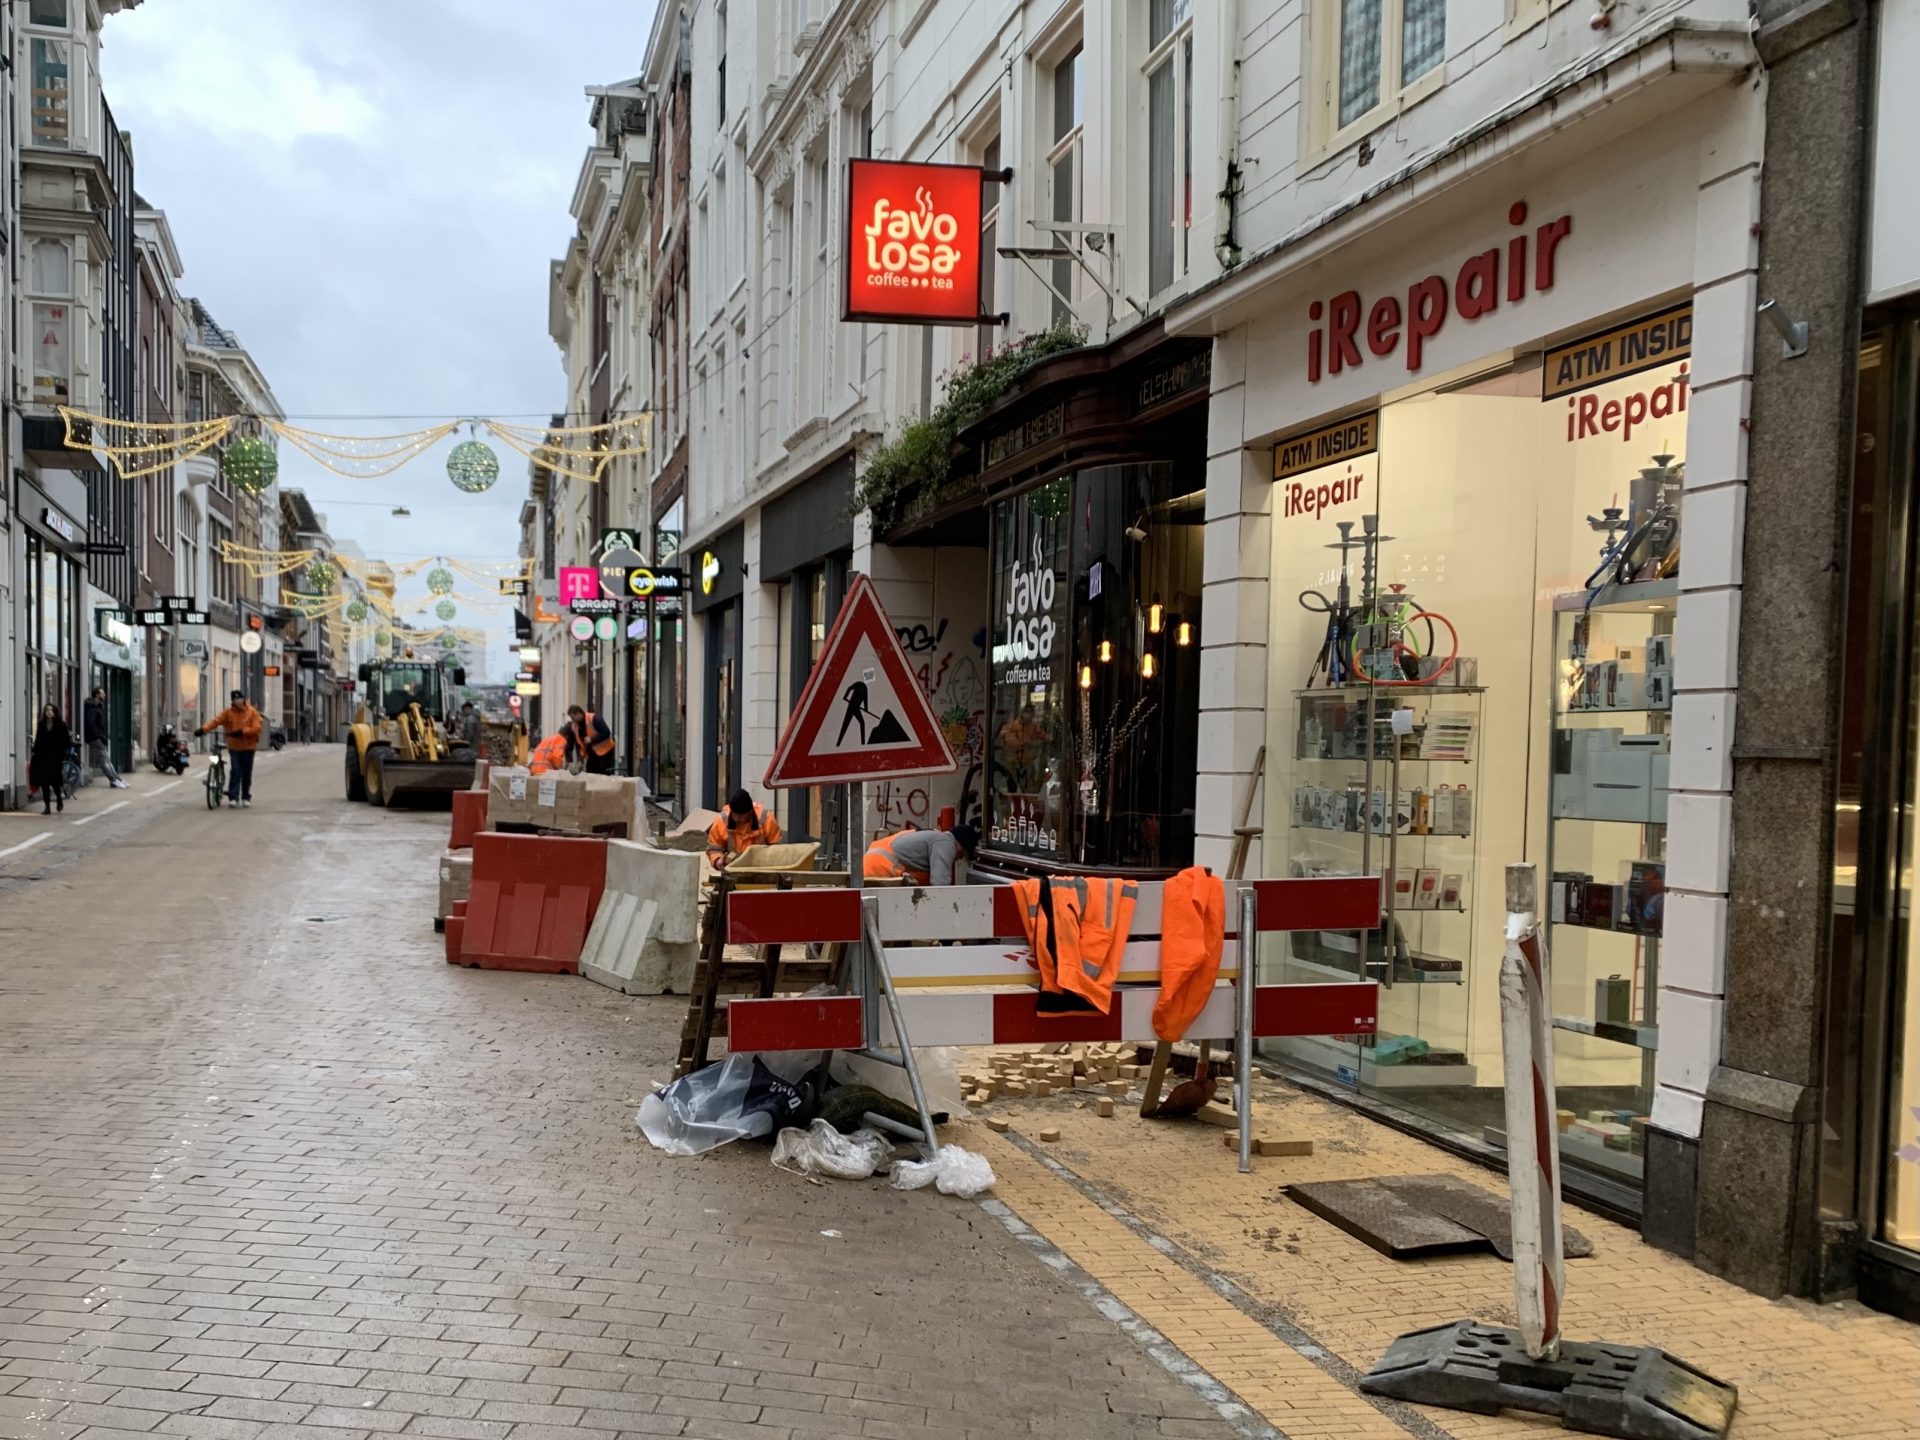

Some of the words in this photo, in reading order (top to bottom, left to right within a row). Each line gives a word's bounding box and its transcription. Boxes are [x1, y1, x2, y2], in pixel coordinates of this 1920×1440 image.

[864, 198, 958, 242] favo
[866, 234, 961, 274] losa
[867, 272, 909, 287] coffee
[931, 275, 954, 289] tea
[1308, 200, 1572, 383] iRepair
[1556, 342, 1612, 386] ATM
[1619, 315, 1693, 366] INSID
[1567, 361, 1689, 443] iRepai
[1281, 440, 1313, 471] ATM
[1316, 422, 1370, 460] INSIDE
[1284, 464, 1364, 521] iRepair
[168, 599, 189, 609] WE
[568, 573, 590, 598] T
[1006, 559, 1055, 615] favo
[144, 612, 165, 624] WE
[186, 613, 205, 623] WE
[1006, 615, 1056, 662] losa
[1005, 664, 1028, 684] coffee
[1038, 664, 1051, 681] tea
